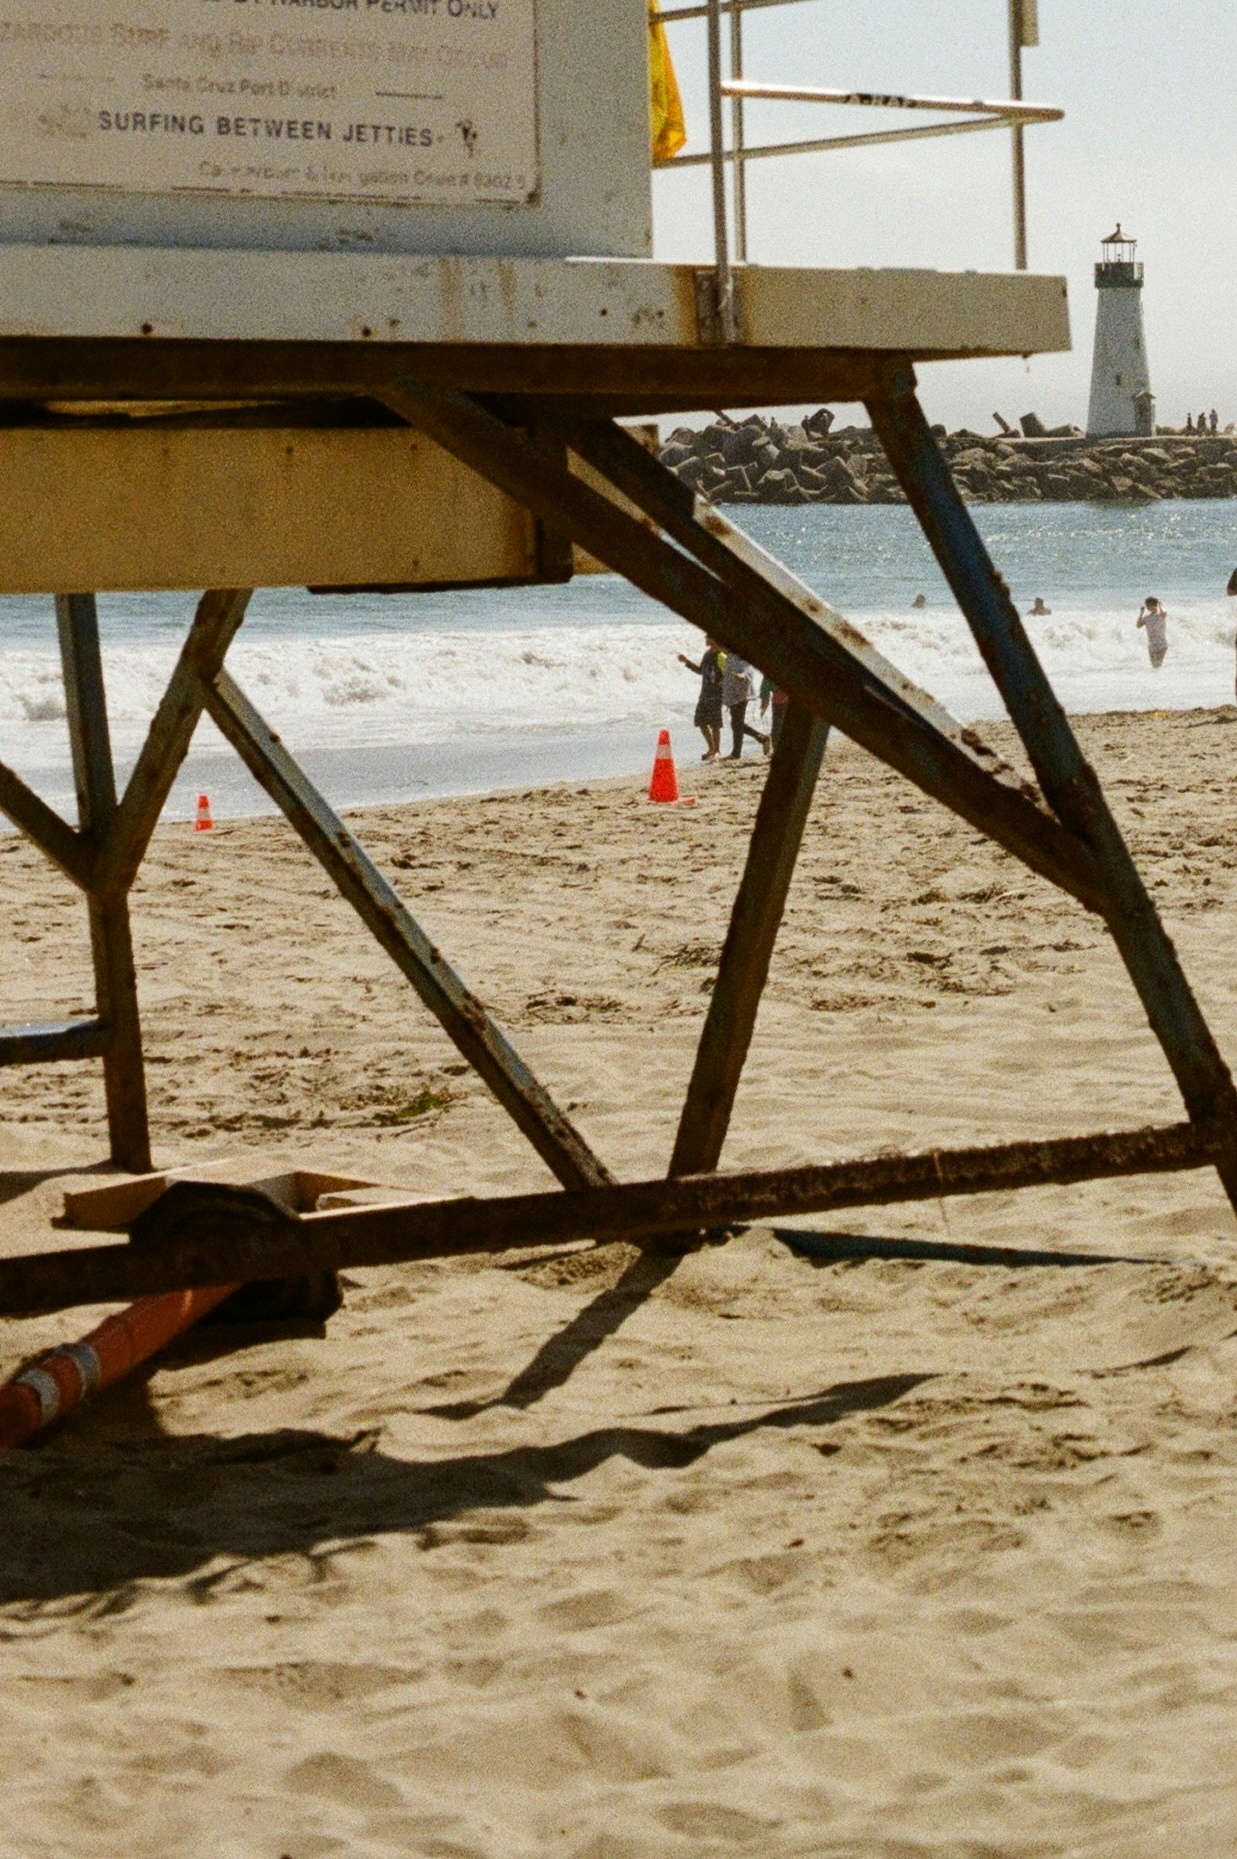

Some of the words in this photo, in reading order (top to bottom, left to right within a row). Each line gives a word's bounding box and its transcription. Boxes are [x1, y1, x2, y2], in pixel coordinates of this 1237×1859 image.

[98, 109, 205, 136] SURFING
[216, 115, 333, 141] BETWEEN
[342, 122, 434, 147] JETTIES
